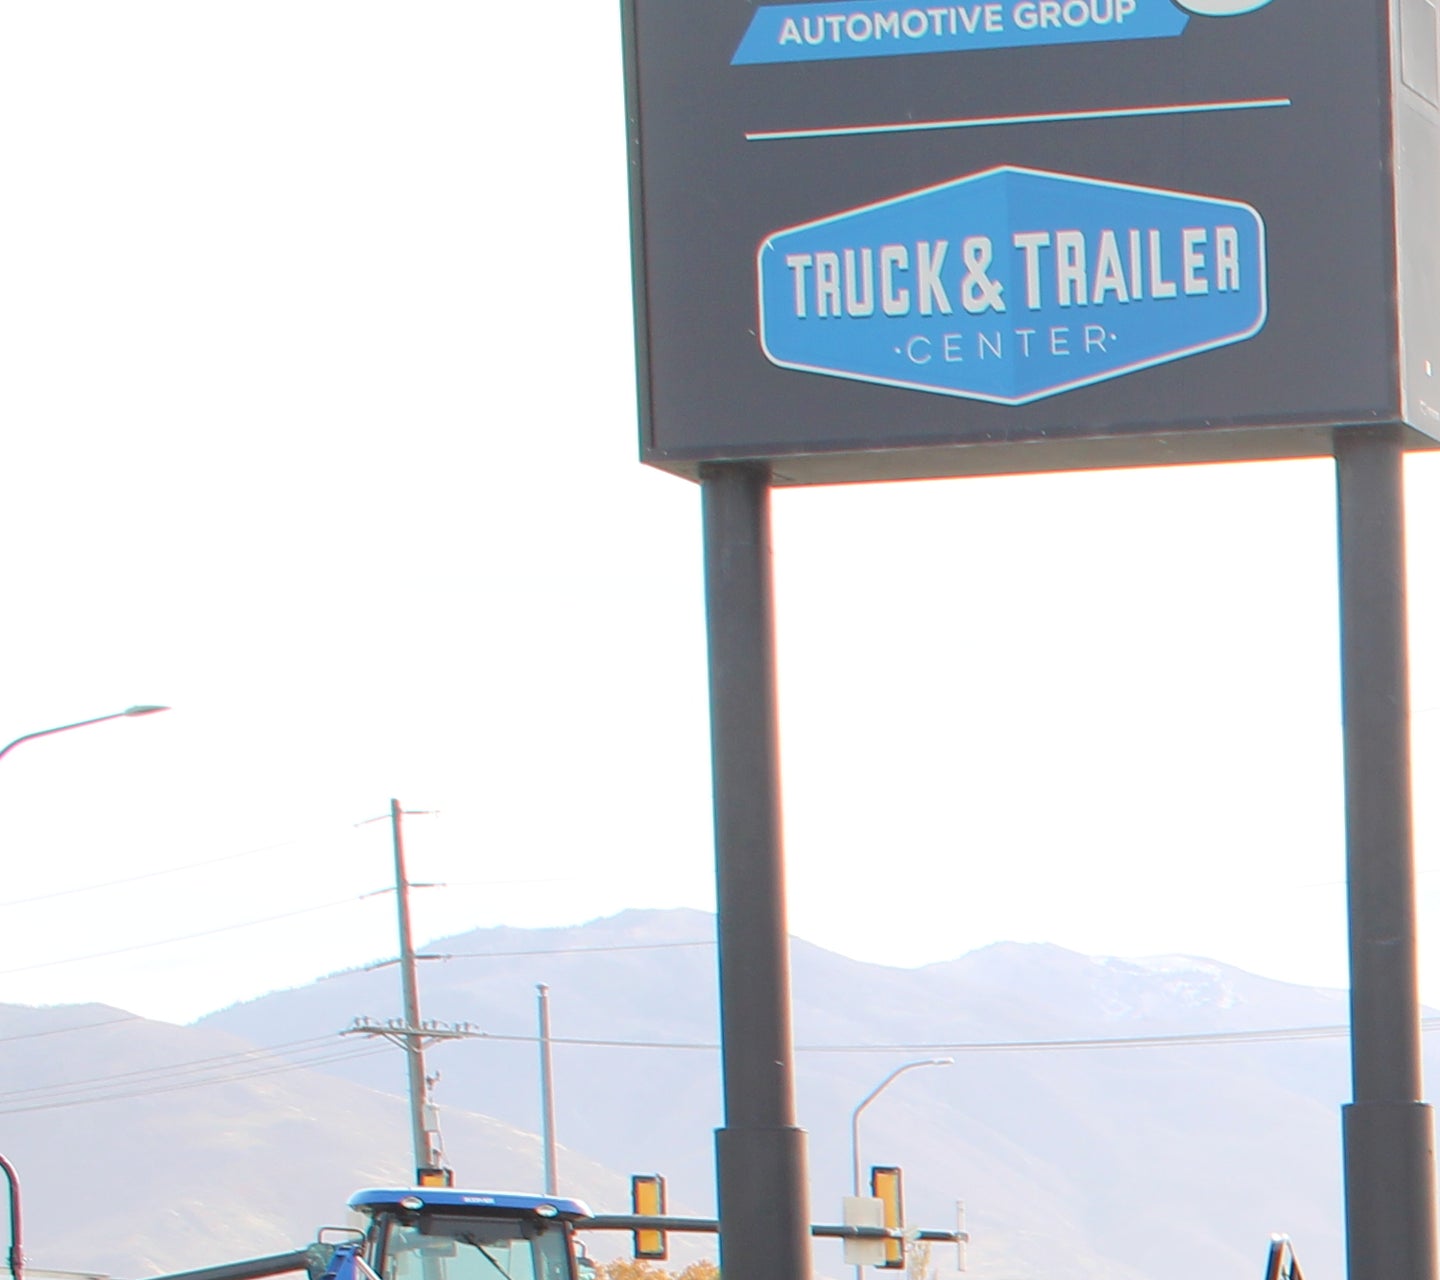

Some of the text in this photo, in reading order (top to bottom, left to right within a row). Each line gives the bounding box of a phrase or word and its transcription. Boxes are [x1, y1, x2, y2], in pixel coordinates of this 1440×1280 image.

[777, 0, 1136, 45] AUTOMOTIVE GROUP
[906, 325, 1107, 364] CENTER
